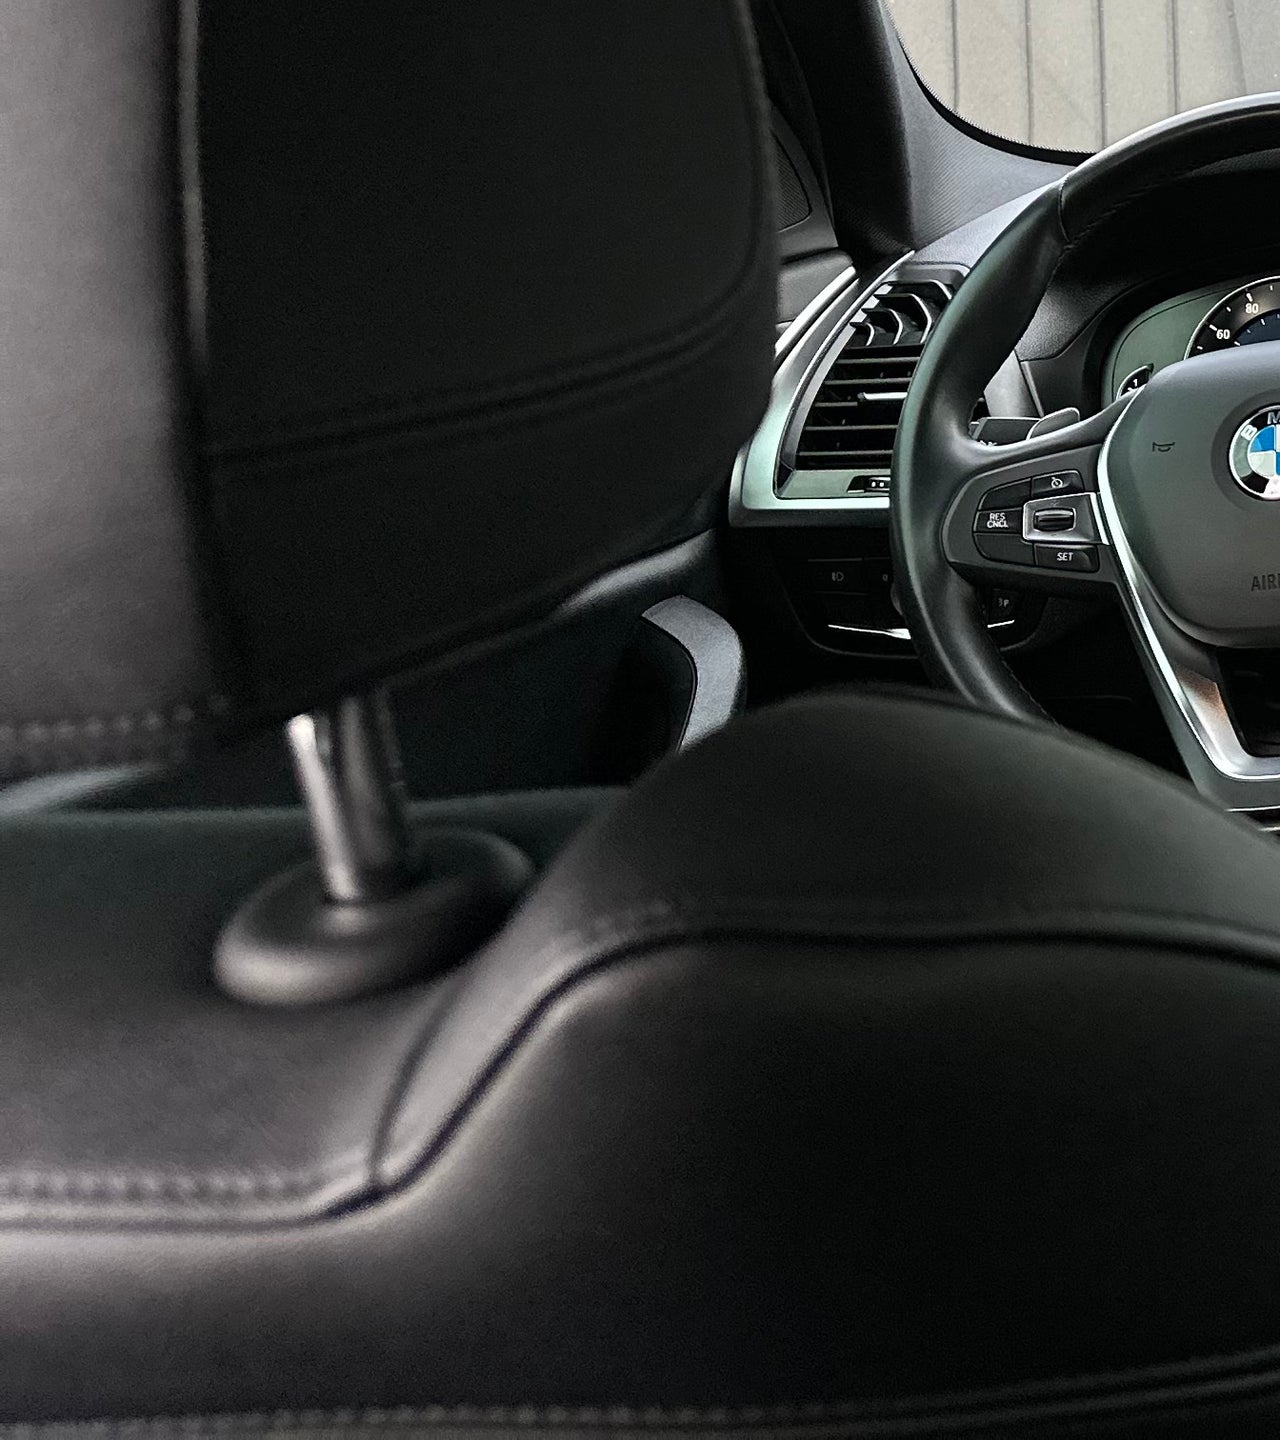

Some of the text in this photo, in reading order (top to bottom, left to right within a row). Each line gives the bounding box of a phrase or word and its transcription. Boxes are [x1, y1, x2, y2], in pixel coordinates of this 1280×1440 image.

[1245, 303, 1259, 314] 80
[1216, 329, 1230, 339] 60
[989, 512, 1006, 521] RES
[1056, 552, 1074, 562] SET
